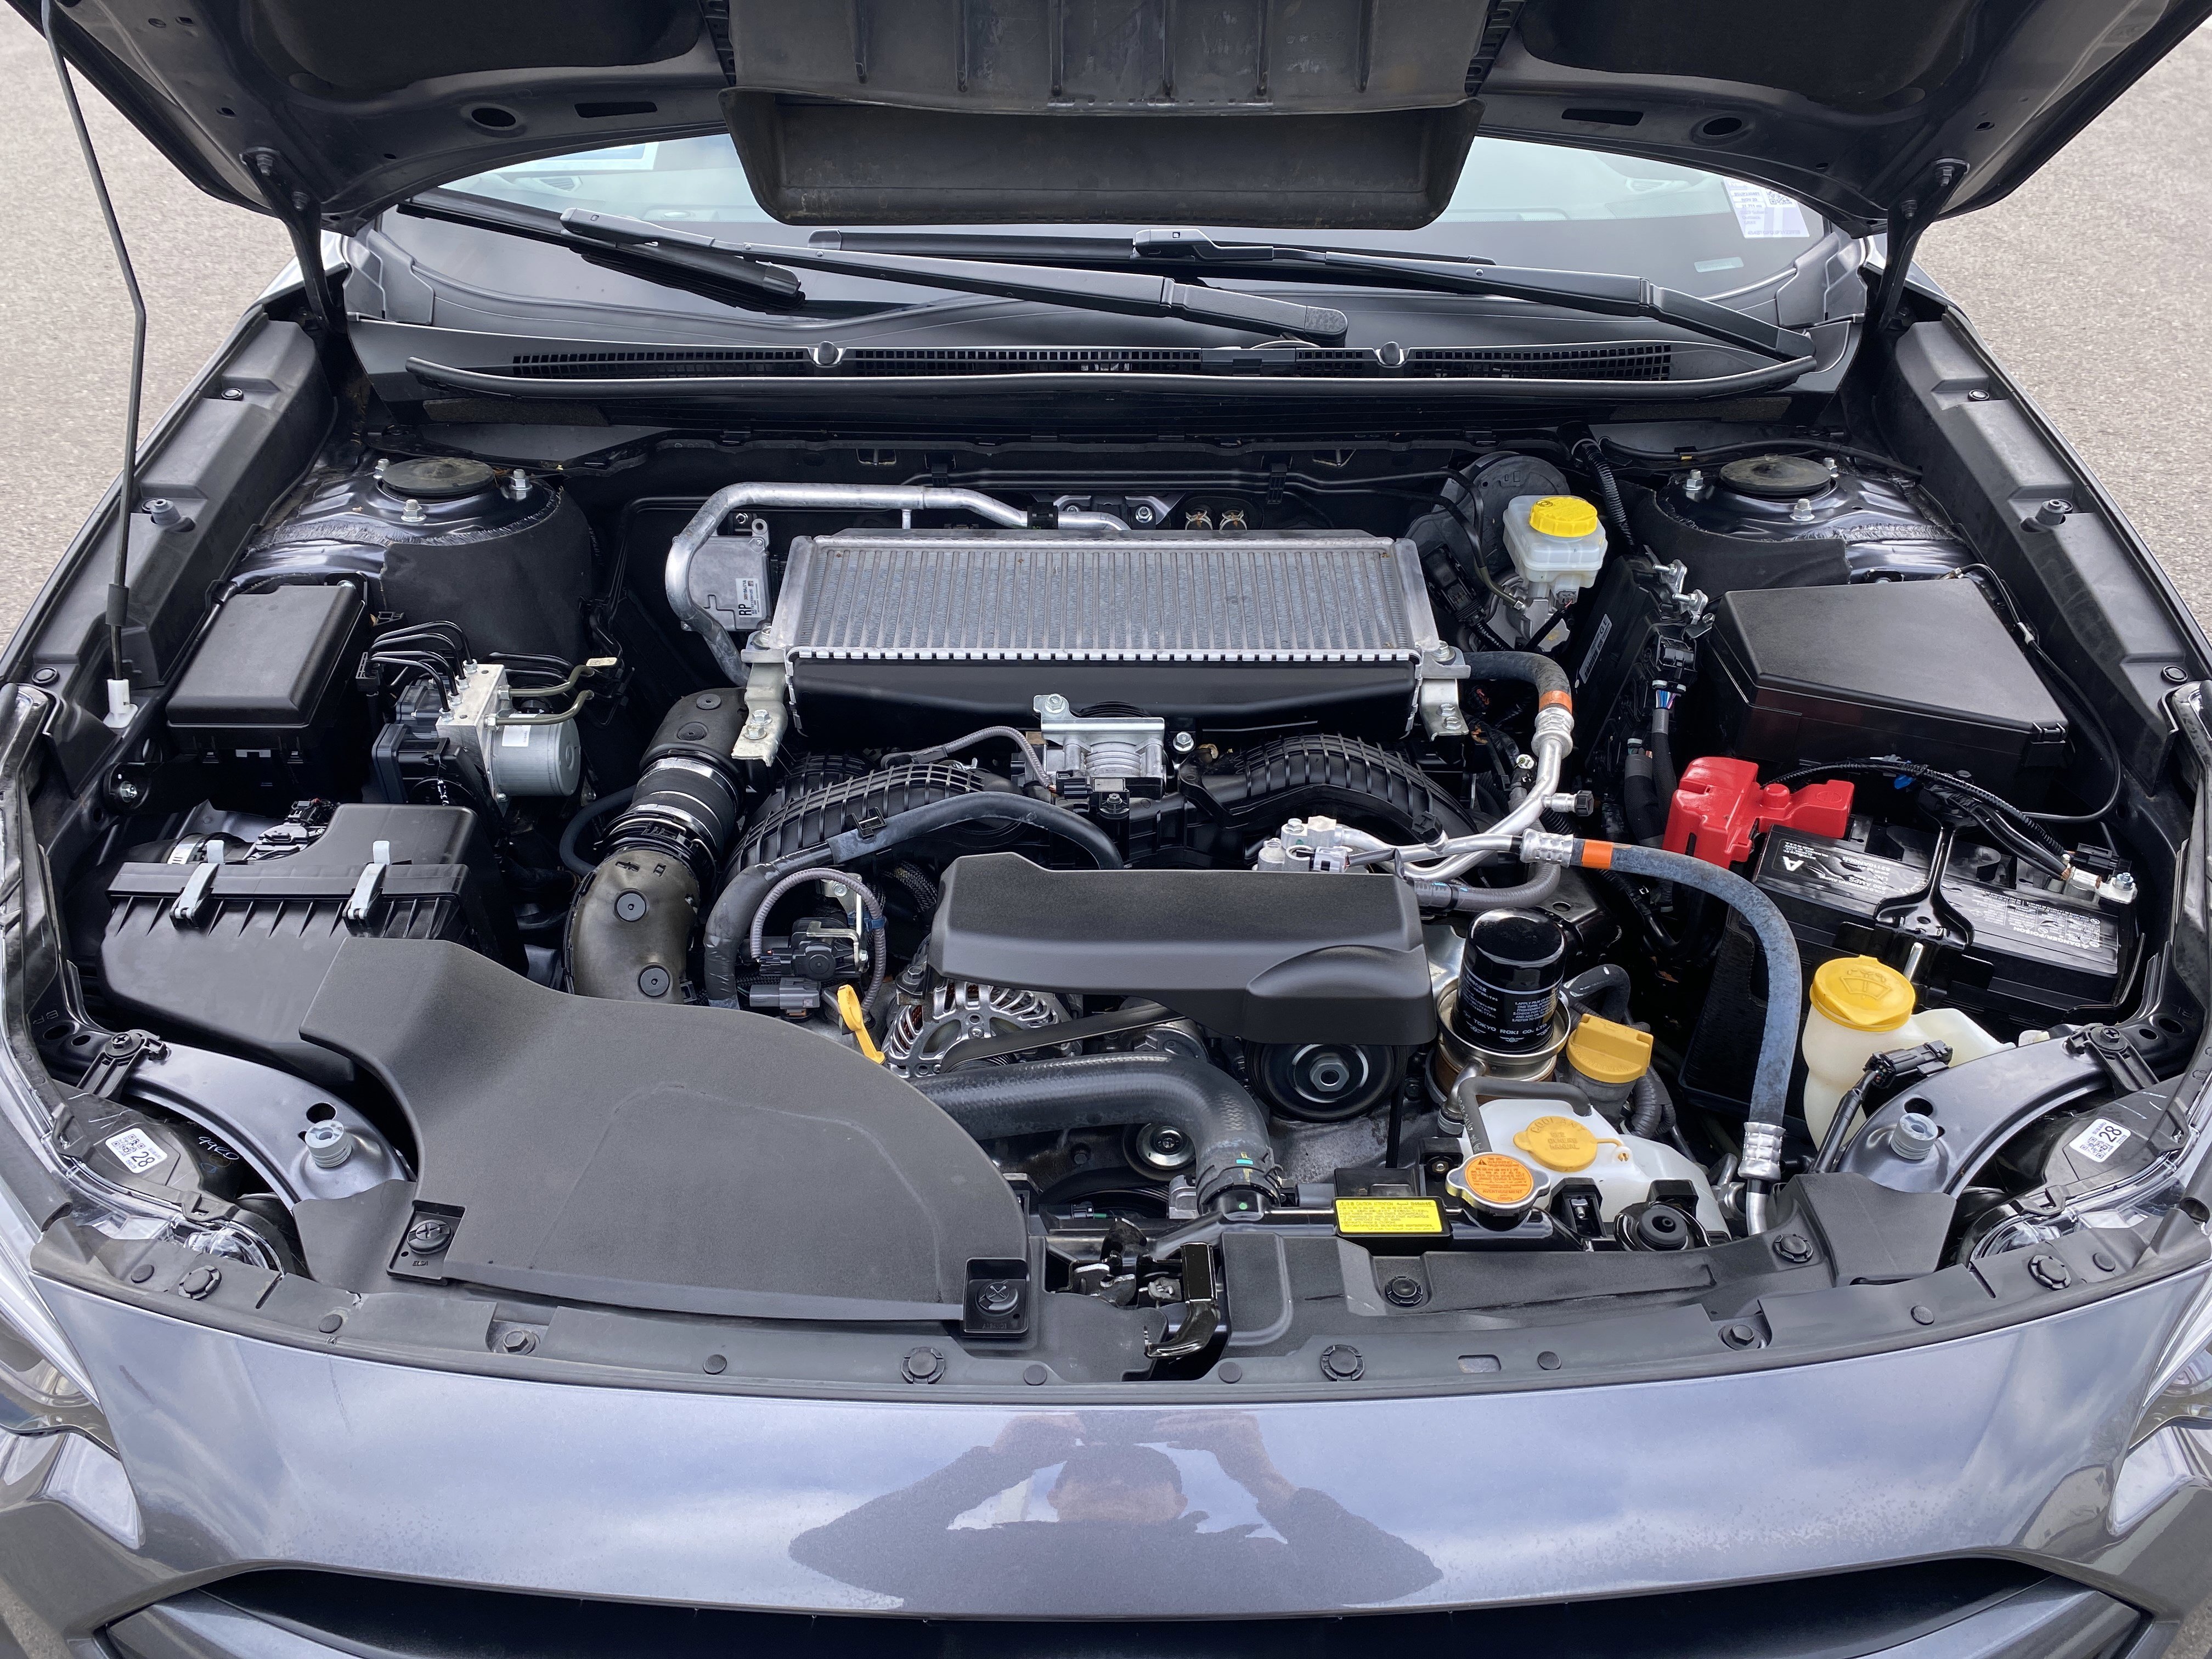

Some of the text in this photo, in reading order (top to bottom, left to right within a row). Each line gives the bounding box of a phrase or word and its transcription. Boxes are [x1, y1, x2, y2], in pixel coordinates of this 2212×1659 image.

[738, 603, 752, 616] RP
[1838, 880, 1868, 890] CRANKING
[1849, 877, 1871, 887] AMPS
[2013, 926, 2081, 947] DANGER/POISON
[1473, 1018, 1497, 1032] TOKYO
[1530, 1116, 1588, 1133] COOLANT
[2098, 1125, 2123, 1142] 28
[131, 1151, 155, 1167] 28
